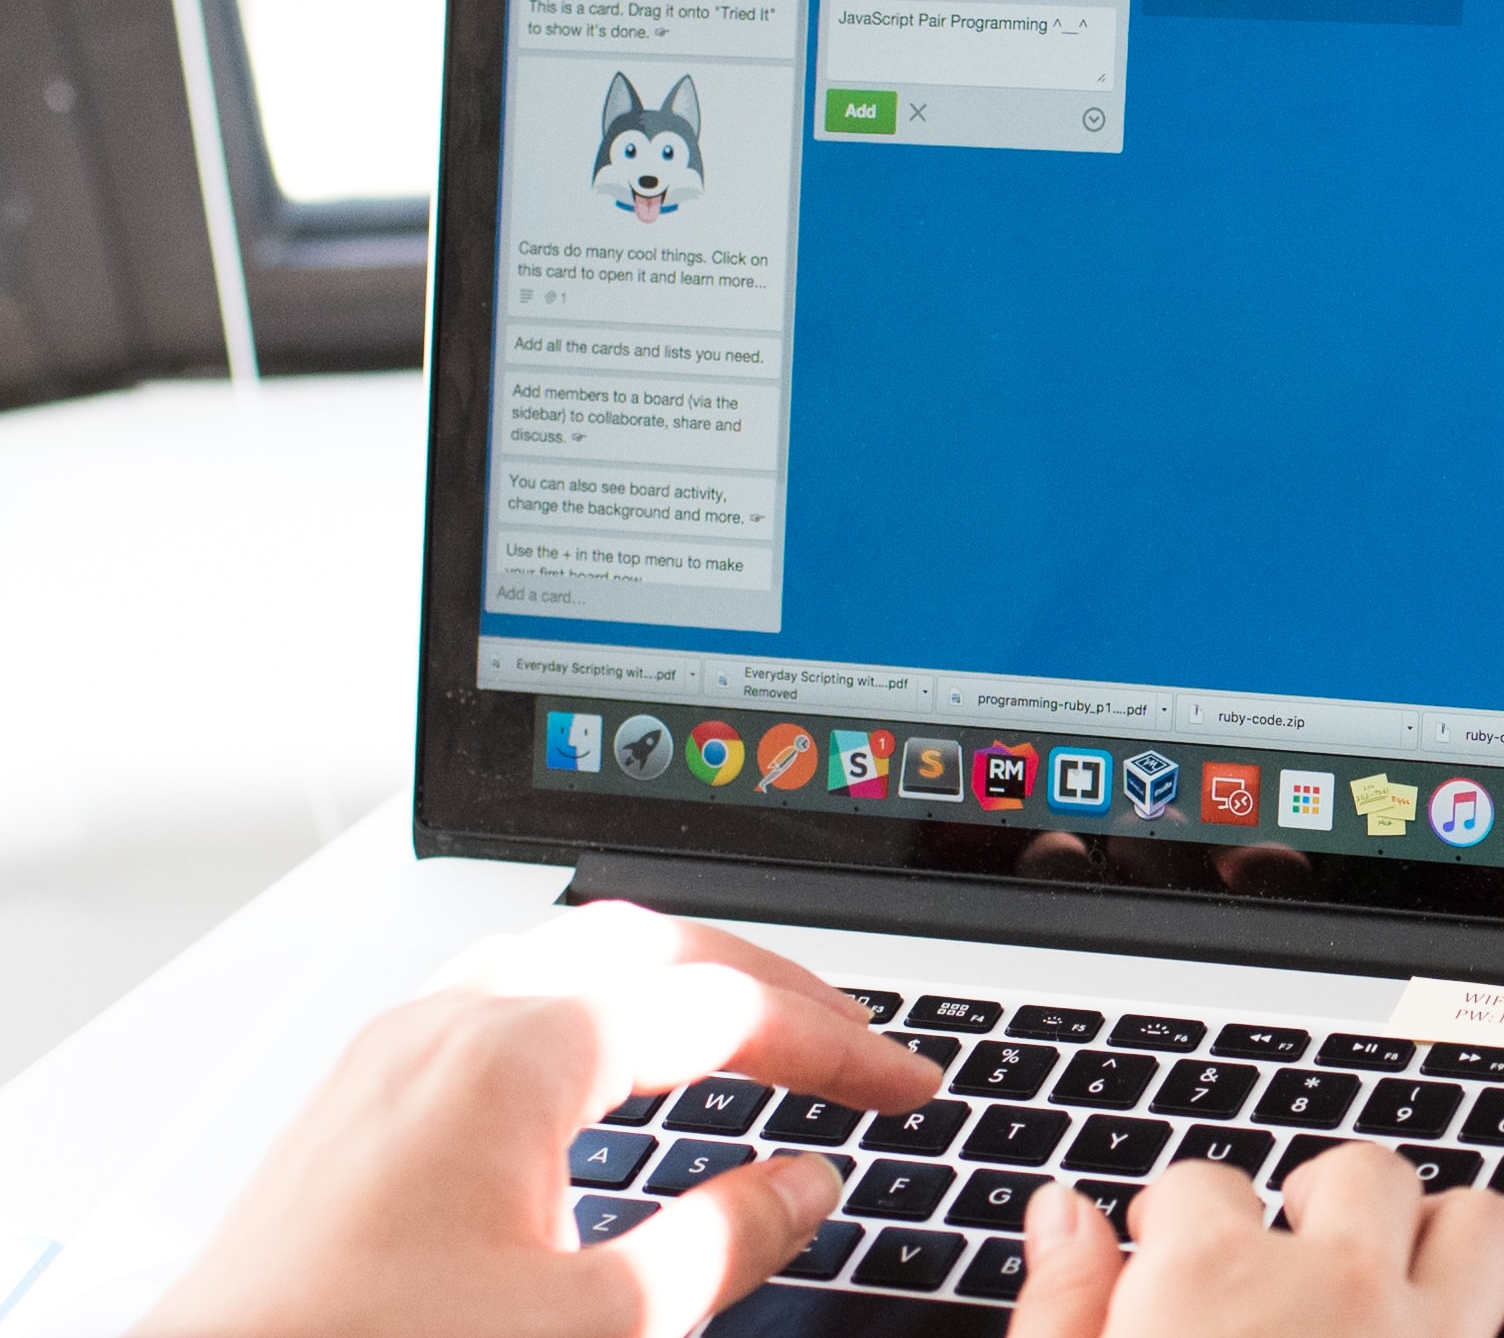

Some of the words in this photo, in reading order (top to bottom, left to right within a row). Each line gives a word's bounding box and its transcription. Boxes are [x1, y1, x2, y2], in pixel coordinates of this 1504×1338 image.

[838, 10, 914, 29] JavaScript
[918, 12, 946, 27] Pair
[950, 13, 1048, 35] Programming
[844, 103, 877, 119] Add
[1218, 711, 1305, 730] ruby-code.zip
[849, 752, 868, 777] S
[989, 759, 1024, 780] RM
[1454, 1008, 1495, 1022] PW:
[988, 1069, 1008, 1082] 5
[1088, 1079, 1104, 1093] 6
[704, 1093, 735, 1110] W
[1191, 1089, 1210, 1102] 7
[805, 1103, 826, 1119] E
[1291, 1098, 1309, 1113] 8
[903, 1114, 924, 1130] R
[1397, 1107, 1413, 1122] 9
[1007, 1123, 1025, 1139] T
[1108, 1133, 1129, 1150] Y
[587, 1147, 609, 1163] A
[688, 1157, 709, 1173] S
[889, 1178, 910, 1194] F
[988, 1188, 1012, 1204] G
[592, 1214, 618, 1231] Z
[900, 1246, 921, 1262] V
